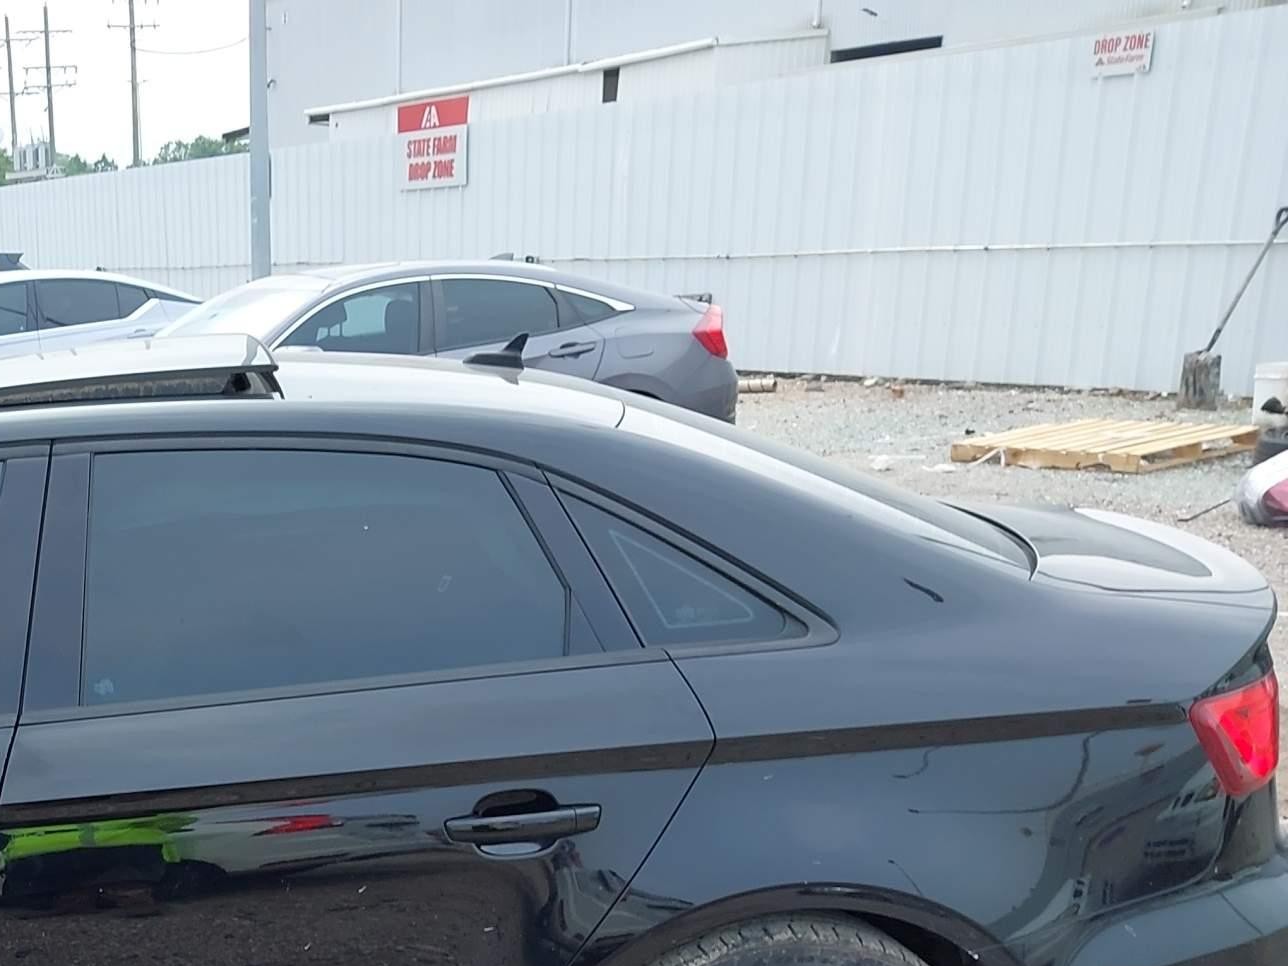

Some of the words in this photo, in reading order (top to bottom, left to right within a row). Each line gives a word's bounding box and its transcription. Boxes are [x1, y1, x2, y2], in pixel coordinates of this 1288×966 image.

[1094, 36, 1122, 56] DROP
[1123, 32, 1151, 51] ZONE
[407, 138, 431, 159] STATE
[432, 135, 457, 155] FARM
[408, 162, 431, 181] DROP
[432, 159, 455, 179] ZONE
